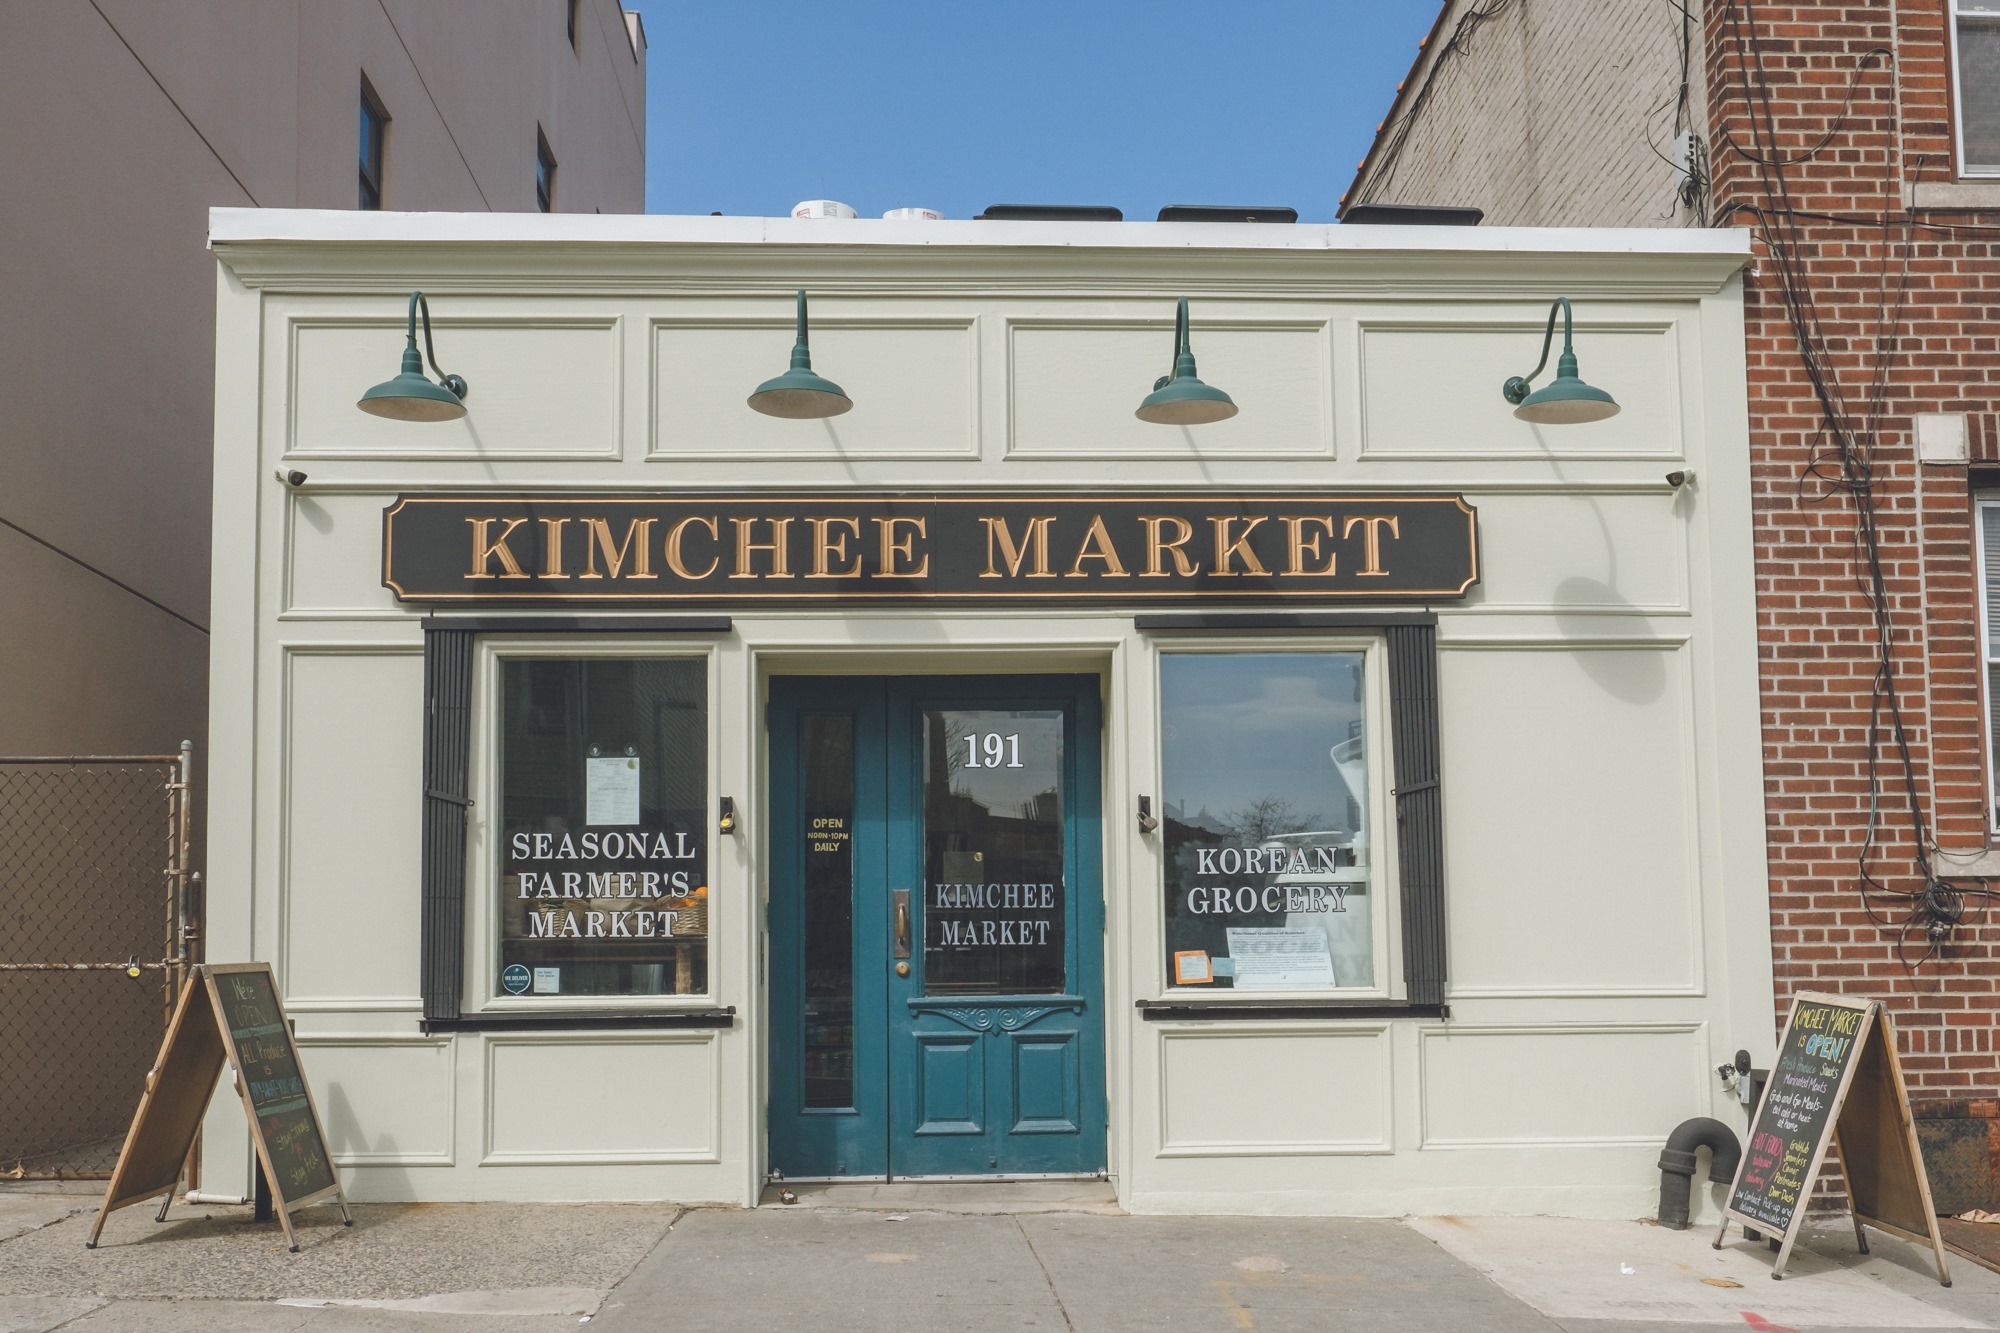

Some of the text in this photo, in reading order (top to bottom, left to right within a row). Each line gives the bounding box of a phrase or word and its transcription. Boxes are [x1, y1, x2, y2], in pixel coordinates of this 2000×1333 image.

[464, 514, 1399, 579] KIMCHEE MARKET
[963, 732, 1025, 769] 191
[813, 818, 843, 828] OPEN
[512, 832, 696, 859] SEASONAL
[814, 842, 840, 851] DAILY
[1196, 847, 1338, 875] KOREAN
[517, 871, 690, 899] FARMER'S
[935, 883, 1054, 908] KIMCHEE
[1187, 886, 1349, 914] GROCERY
[528, 911, 678, 938] MARKET
[940, 920, 1050, 945] MARKET
[1793, 1004, 1866, 1037] KIMCHEE MARKET
[256, 1040, 287, 1060] Produce
[1798, 1033, 1850, 1064] is OPEN!
[1796, 1057, 1817, 1074] Produce
[1820, 1062, 1839, 1079] Snacks
[1769, 1089, 1781, 1104] Grab
[1808, 1077, 1827, 1094] Meats
[1784, 1119, 1798, 1132] home
[1798, 1111, 1812, 1123] heat
